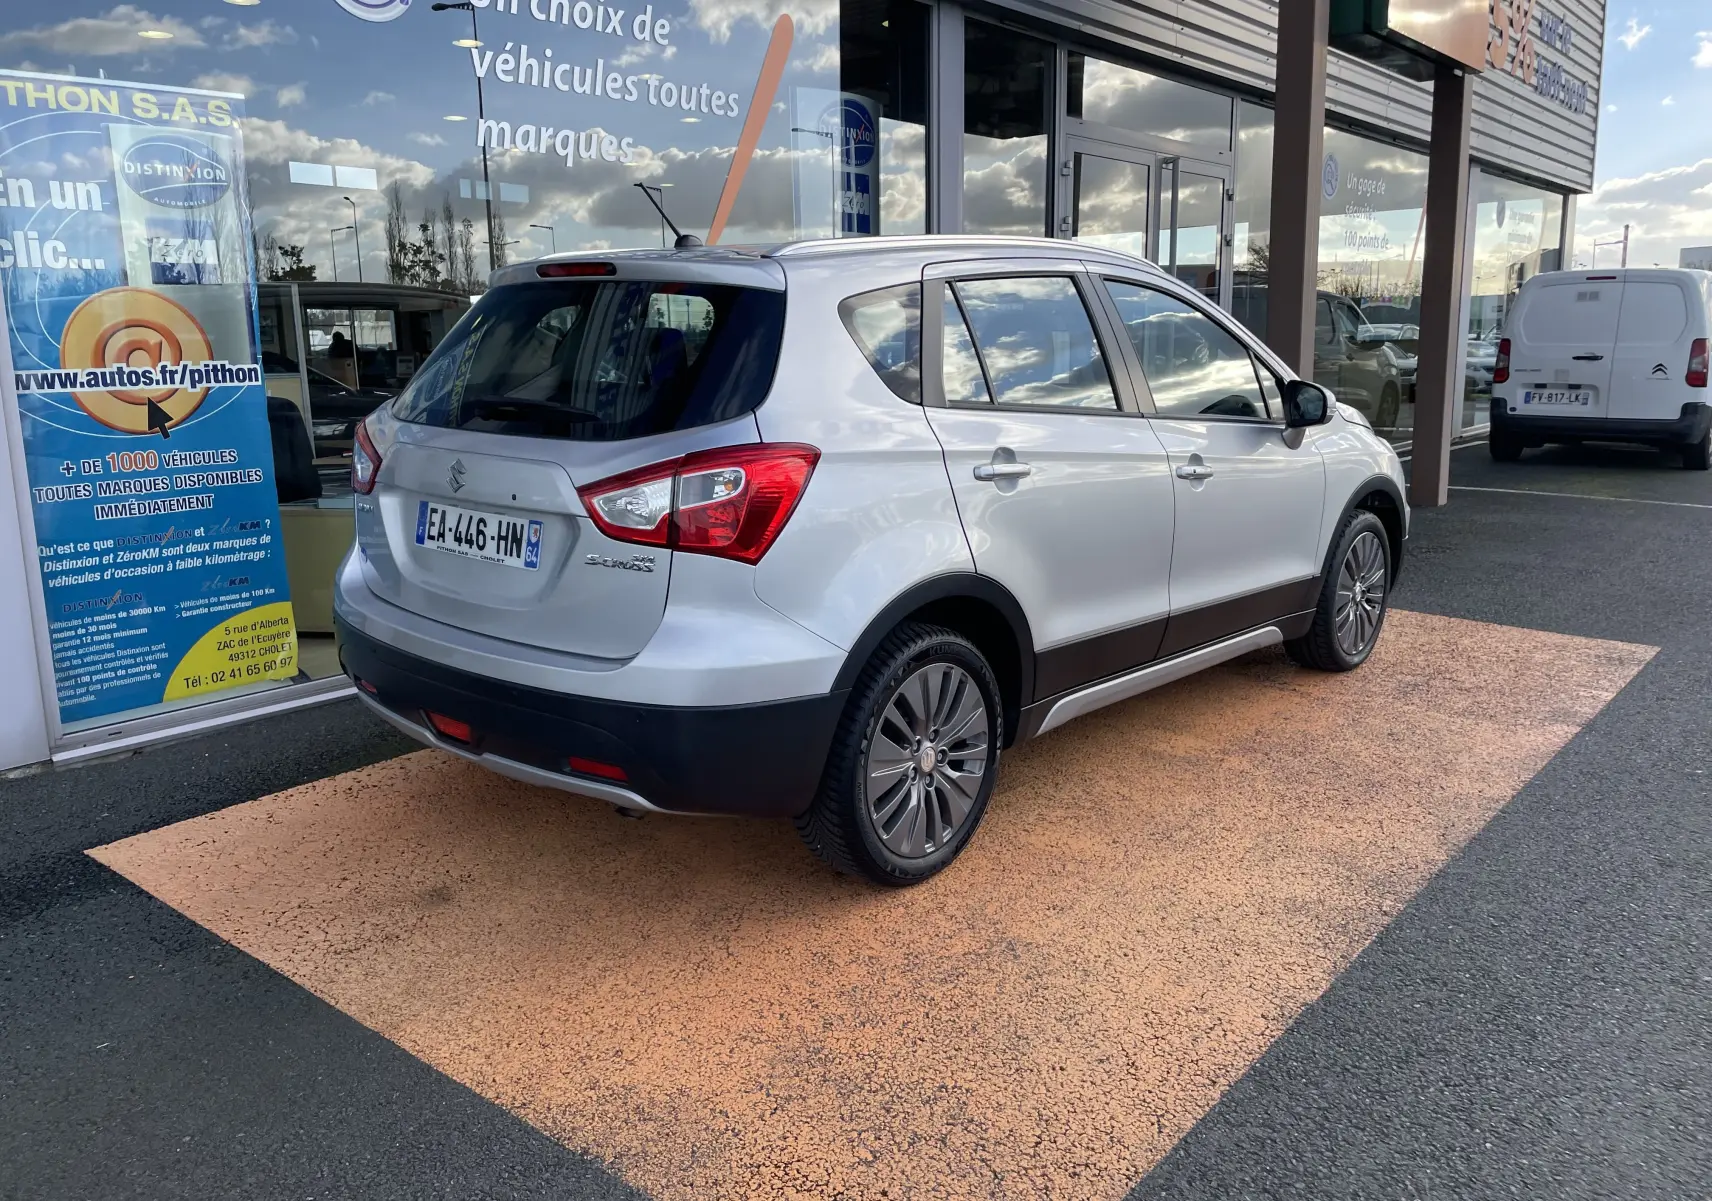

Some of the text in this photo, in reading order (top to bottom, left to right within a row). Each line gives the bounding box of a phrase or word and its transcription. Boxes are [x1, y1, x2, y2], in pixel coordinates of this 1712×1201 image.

[530, 0, 671, 46] choix de
[471, 42, 740, 118] véhicules toutes
[476, 117, 634, 167] marques
[124, 161, 226, 181] DISTINXION
[49, 180, 102, 211] un
[1377, 177, 1386, 195] de
[1344, 230, 1357, 246] 100
[1357, 232, 1380, 250] points
[15, 363, 259, 391] www.autos.fr/pithon
[82, 460, 102, 475] DE
[107, 451, 158, 473] 1000
[163, 450, 237, 468] VÉHICULES
[34, 470, 262, 502] TOUTES MARQUES DISPONIBLES
[95, 494, 213, 520] IMMÉDIATEMENT
[77, 543, 90, 552] ce
[93, 539, 114, 551] que
[116, 527, 193, 547] DISTINXION
[195, 527, 205, 537] et
[265, 519, 271, 528] ?
[426, 507, 525, 559] EA-446-HN
[44, 534, 271, 572] Distinxion et ZéroKM sont deux marques de
[526, 546, 538, 562] 64
[48, 572, 101, 588] véhicules
[104, 562, 164, 579] d'occasion
[167, 561, 173, 571] à
[176, 556, 202, 570] faible
[63, 590, 144, 612] DISTINXION
[180, 598, 208, 609] Véhicules
[220, 594, 240, 602] moins
[251, 589, 263, 597] 100
[265, 587, 275, 595] Km
[181, 600, 252, 618] Garantie constructeur
[83, 616, 92, 624] de
[94, 613, 116, 622] moins
[129, 607, 152, 617] 30000
[154, 605, 166, 613] Km
[53, 622, 117, 639] moins de 30 mois
[82, 636, 91, 644] 12
[93, 633, 112, 642] mois
[113, 627, 148, 639] minimum
[224, 617, 289, 635] 5 rue d'Alberta
[78, 642, 115, 655] accidentés
[117, 646, 150, 657] Distinxion
[151, 643, 166, 651] sont
[217, 639, 235, 651] ZAC
[238, 638, 248, 646] de
[228, 642, 293, 662] 49312 CHOLET
[103, 657, 135, 669] contrôlés
[144, 651, 169, 662] vérifiés
[77, 676, 90, 684] 100
[92, 671, 116, 682] points
[117, 668, 126, 676] de
[128, 663, 157, 674] contrôle
[184, 656, 293, 689] Tél : 02 41 65 60 97
[76, 687, 87, 695] par
[103, 673, 151, 689] professionnels
